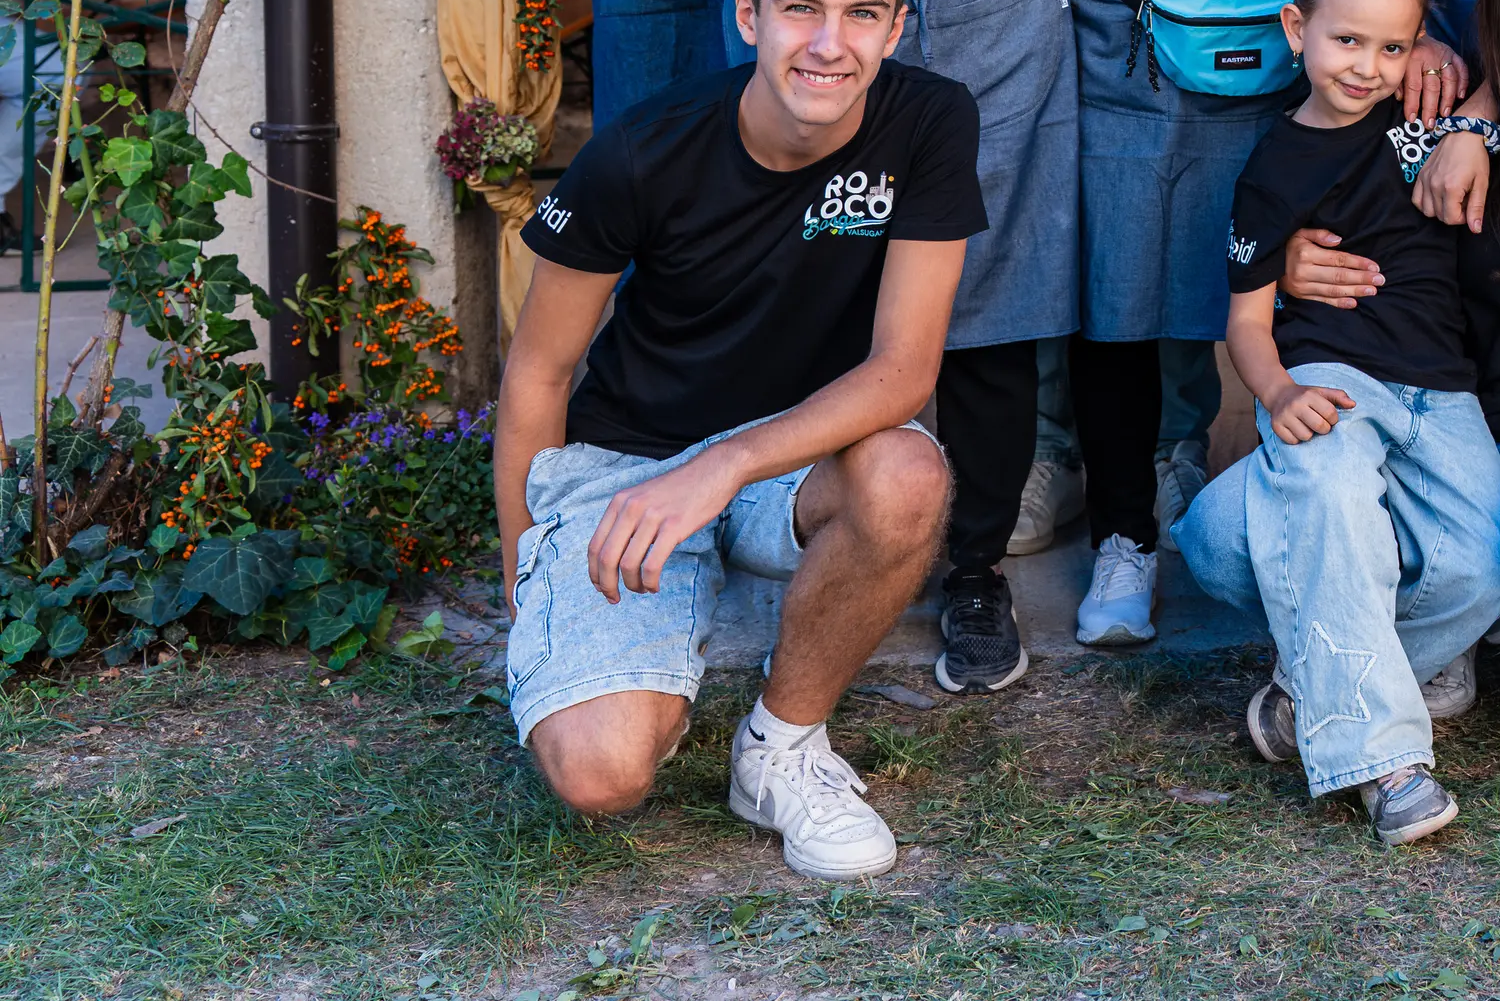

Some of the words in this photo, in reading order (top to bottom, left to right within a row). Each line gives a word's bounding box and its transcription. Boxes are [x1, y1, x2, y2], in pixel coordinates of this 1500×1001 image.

[1221, 56, 1255, 64] EASTPAK
[824, 170, 868, 199] RO
[537, 195, 572, 234] eidi
[802, 214, 864, 240] Borgo
[846, 228, 886, 238] VALSUGAN
